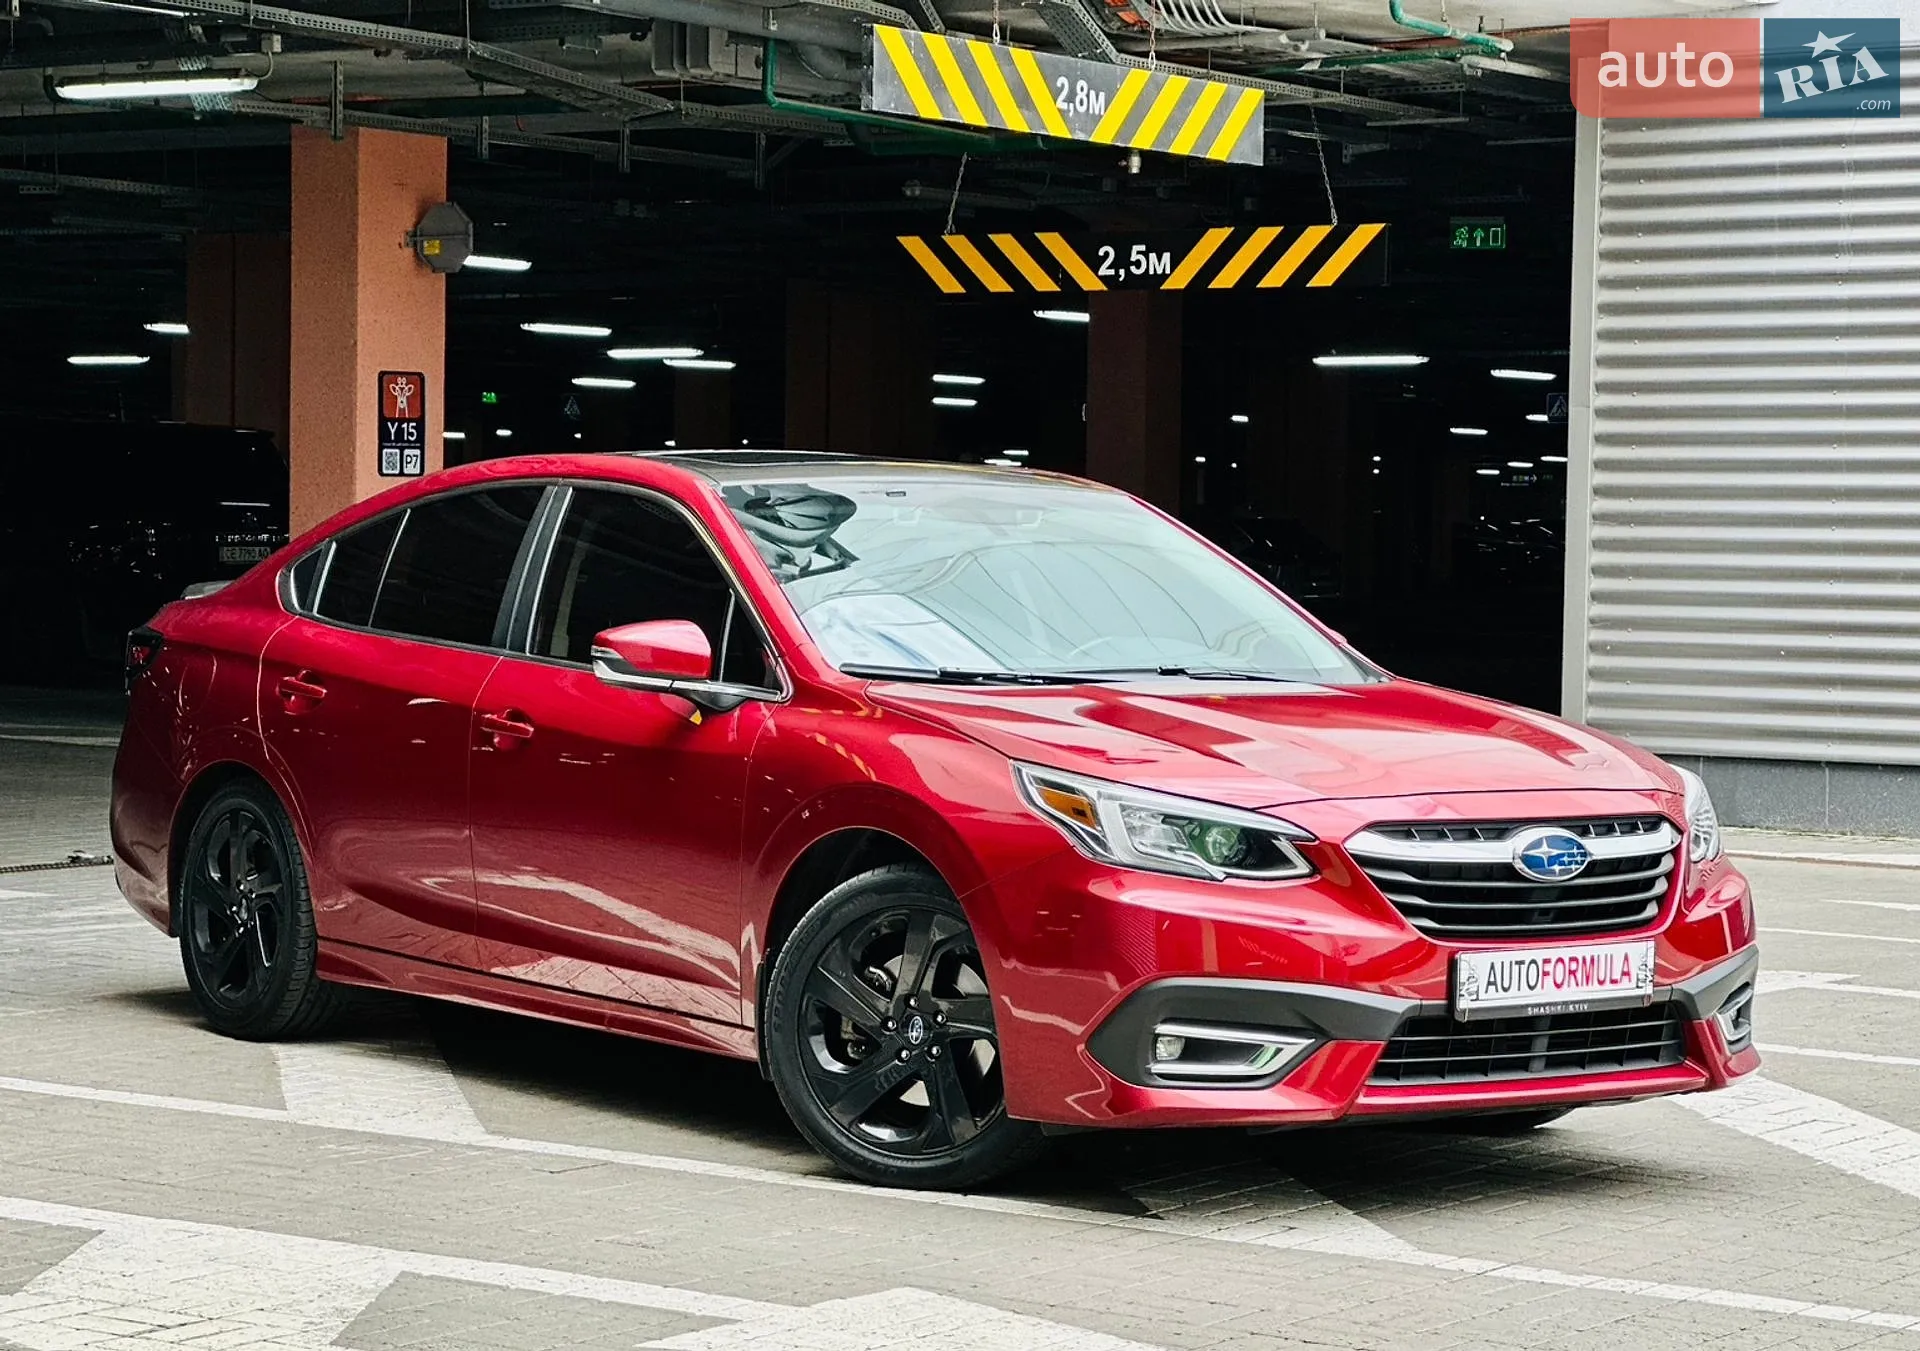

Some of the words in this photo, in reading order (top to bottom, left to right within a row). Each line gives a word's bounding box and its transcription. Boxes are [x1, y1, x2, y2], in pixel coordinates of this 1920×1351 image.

[387, 421, 398, 441] Y
[401, 422, 418, 441] 15
[405, 454, 419, 469] P7
[1484, 952, 1632, 994] AUTOFORMULA
